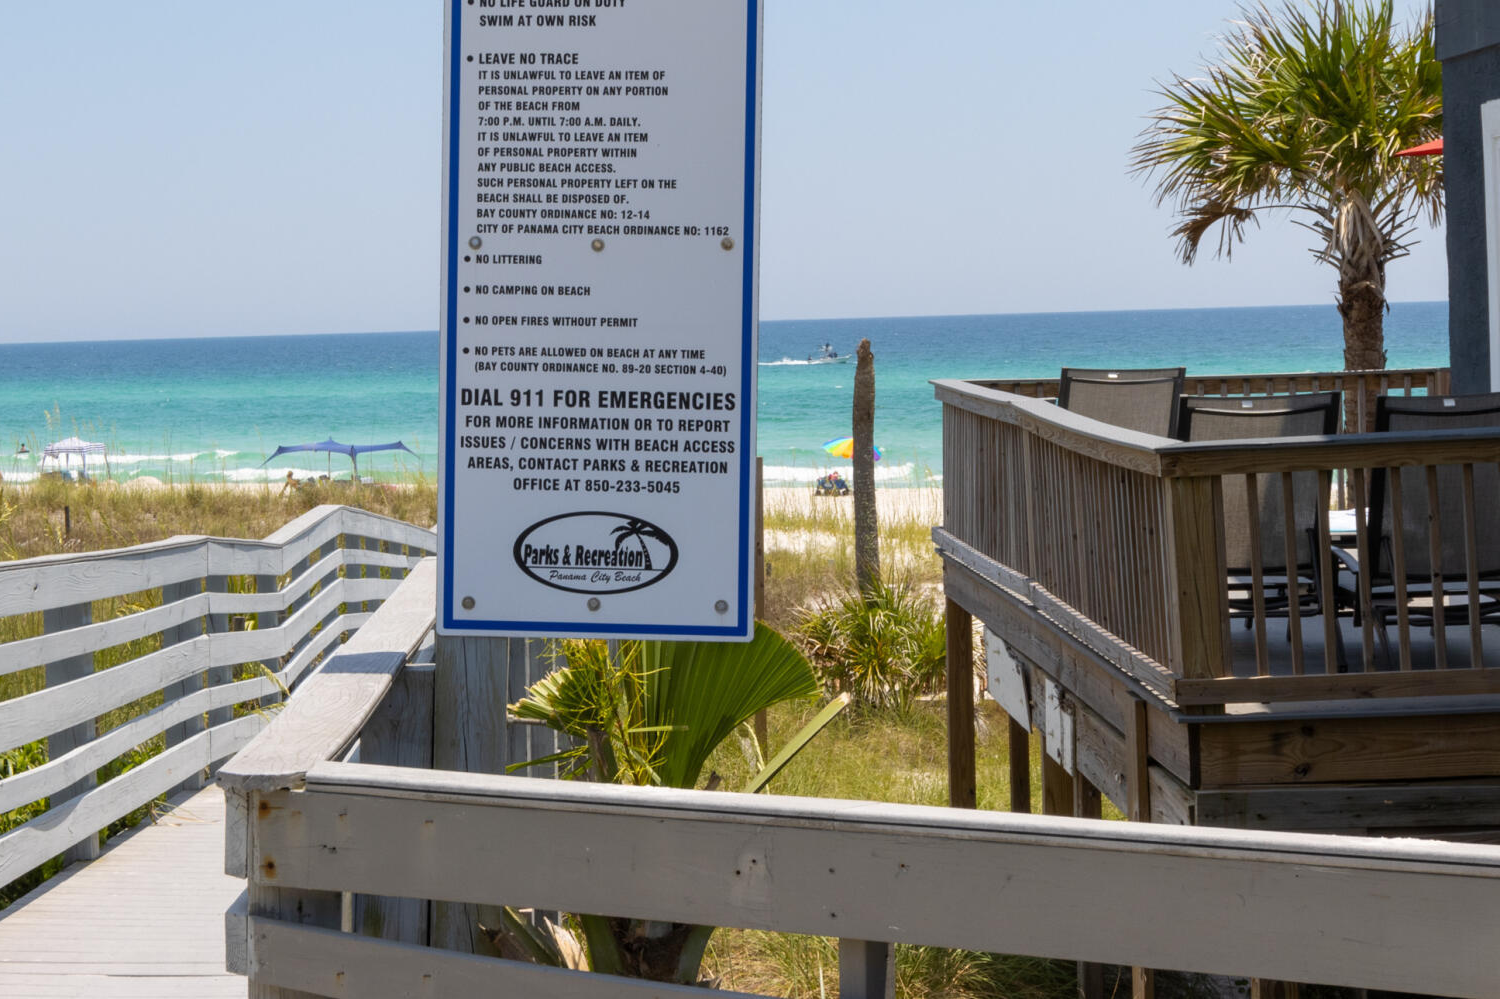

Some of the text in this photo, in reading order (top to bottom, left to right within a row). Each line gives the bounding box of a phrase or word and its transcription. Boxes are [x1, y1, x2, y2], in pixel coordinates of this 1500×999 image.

[479, 14, 596, 26] SWIM AT OWN RISK
[478, 52, 578, 64] LEAVE NO TRACE
[478, 70, 665, 80] IT IS UNLAWFUL TO LEAVE AN ITEM OF
[478, 116, 640, 126] 7:00 P.M. UNTIL 7:00 A.M. DAILY.
[475, 254, 542, 264] NO LITTERING
[475, 284, 590, 295] NO CAMPING ON BEACH
[461, 388, 735, 411] DIAL 911 FOR EMERGENCIES
[465, 415, 730, 432] FOR MORE INFORMATION OR TO REPORT
[460, 435, 505, 448] ISSUES
[520, 436, 591, 450] CONCERNS
[595, 438, 629, 451] WITH
[634, 439, 678, 452] BEACH
[683, 439, 735, 453] ACCESS
[467, 456, 727, 473] AREAS, CONTACT PARKS & RECREATION
[513, 477, 680, 493] OFFICE AT 850-233-5045
[524, 544, 643, 567] Parks & Recreation
[550, 570, 641, 583] Panama City Beach
